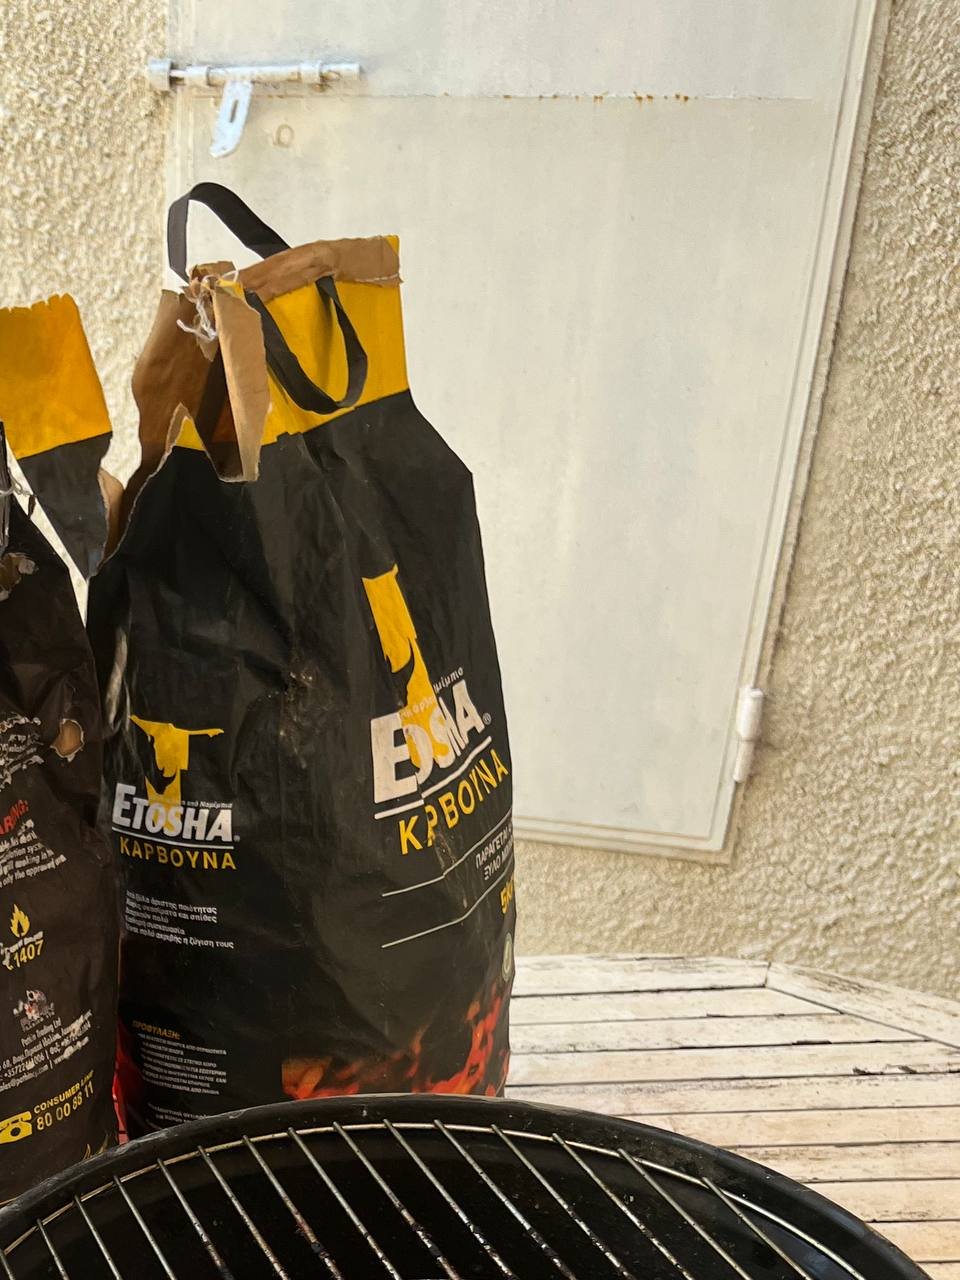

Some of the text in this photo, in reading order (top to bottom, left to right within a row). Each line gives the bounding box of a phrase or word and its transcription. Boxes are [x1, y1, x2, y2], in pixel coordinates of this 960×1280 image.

[112, 783, 234, 842] ETOSHA
[120, 837, 238, 870] ΚΑΡΒΟΥΝΑ
[215, 941, 234, 949] τους
[33, 1082, 80, 1114] CONSUMER
[36, 1112, 53, 1131] 80
[55, 1102, 71, 1121] 00
